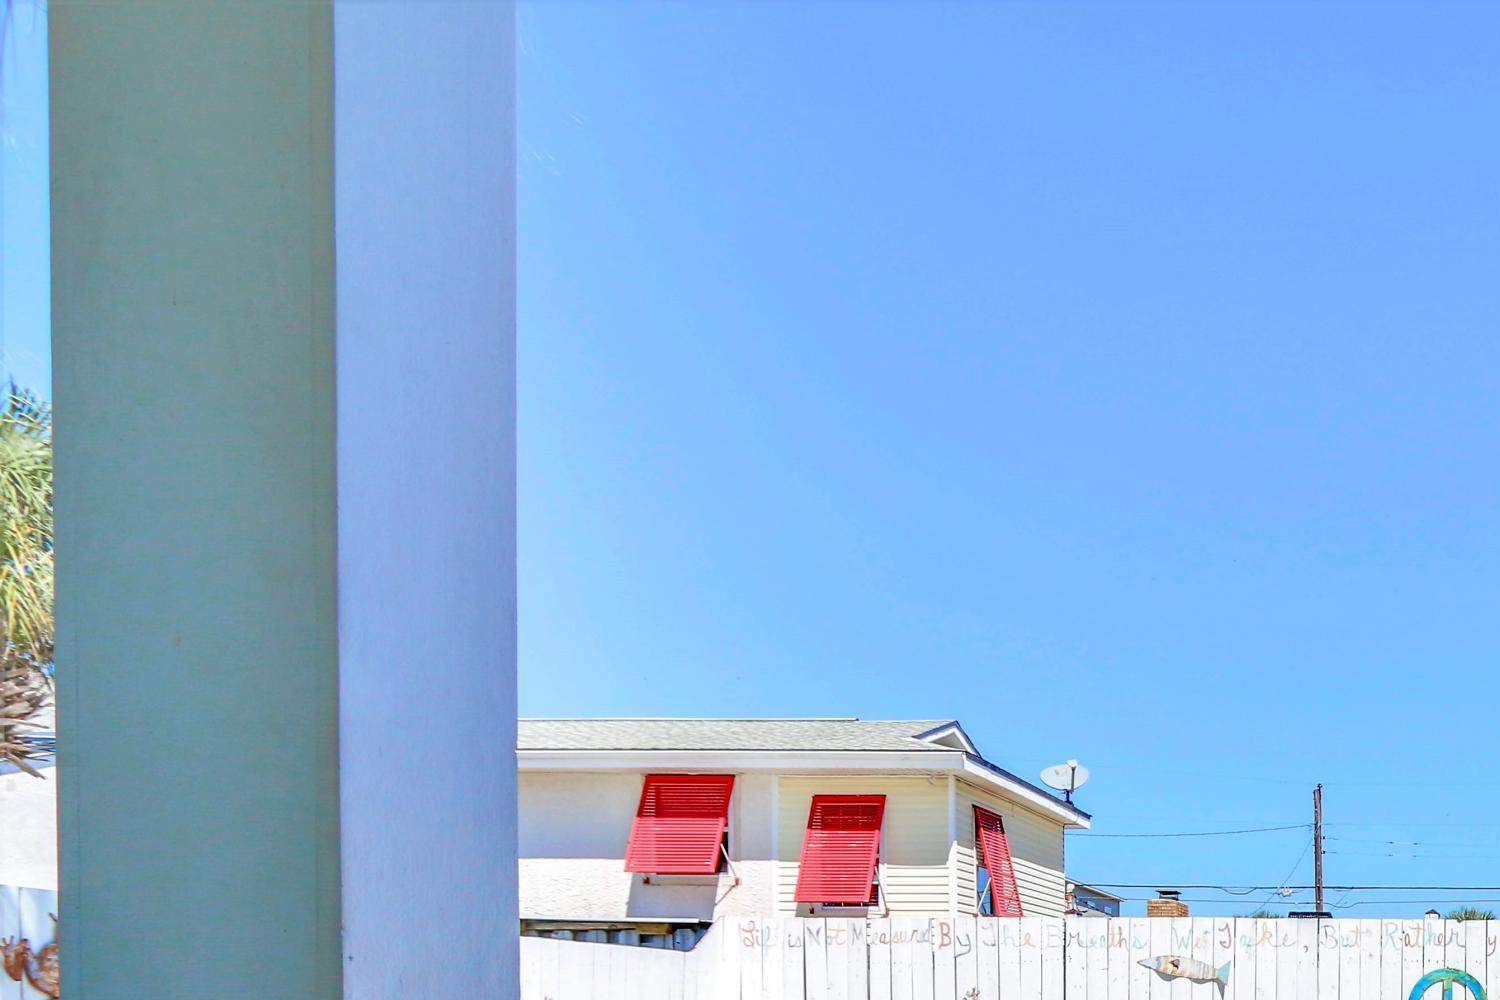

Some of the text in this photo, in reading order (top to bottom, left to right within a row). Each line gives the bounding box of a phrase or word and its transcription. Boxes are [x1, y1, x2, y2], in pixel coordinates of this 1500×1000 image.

[787, 933, 802, 948] is
[806, 924, 847, 947] Not
[938, 921, 971, 959] By
[981, 922, 1037, 948] The
[1320, 923, 1362, 949] But
[1383, 922, 1465, 949] Rather
